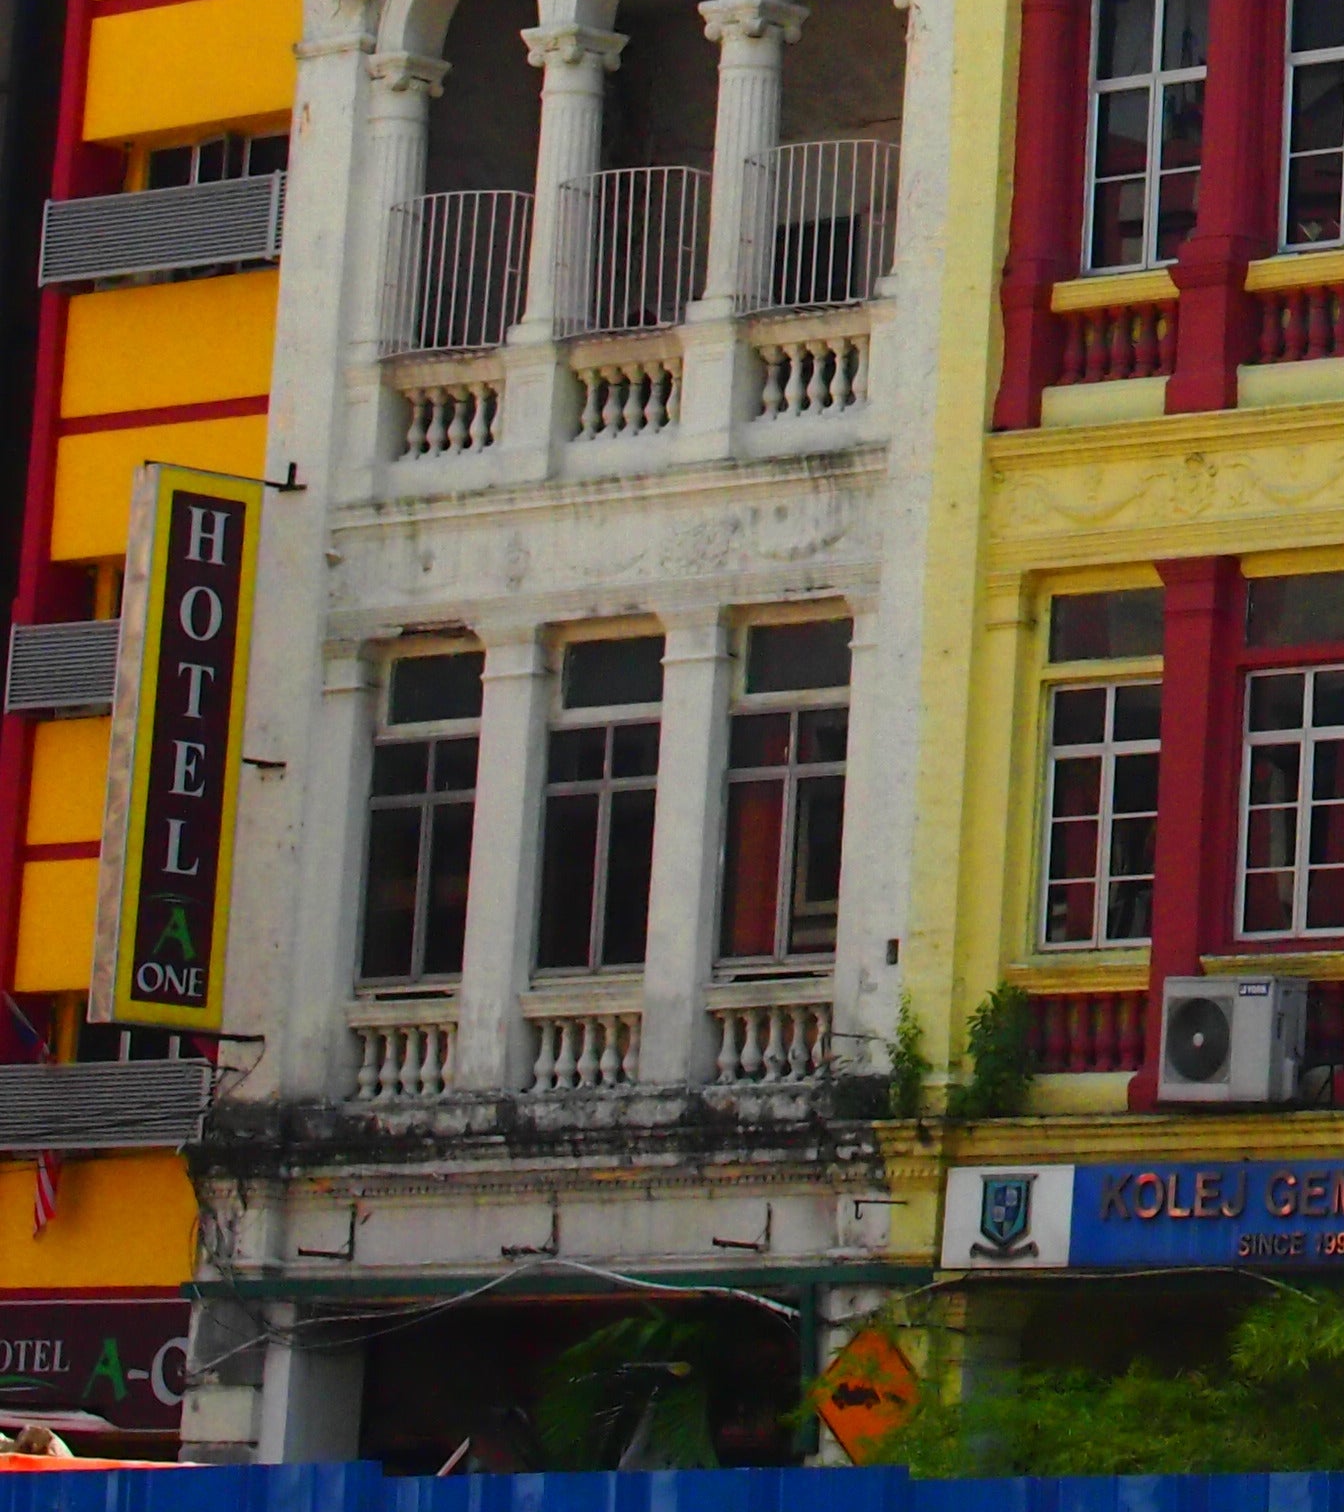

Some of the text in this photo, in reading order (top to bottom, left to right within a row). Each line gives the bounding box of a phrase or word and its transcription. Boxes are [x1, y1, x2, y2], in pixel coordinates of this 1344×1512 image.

[161, 505, 231, 876] HOTEL
[152, 906, 198, 962] A
[137, 962, 204, 998] ONE
[1101, 1169, 1248, 1221] KOLEJ
[1238, 1232, 1302, 1258] SINCE
